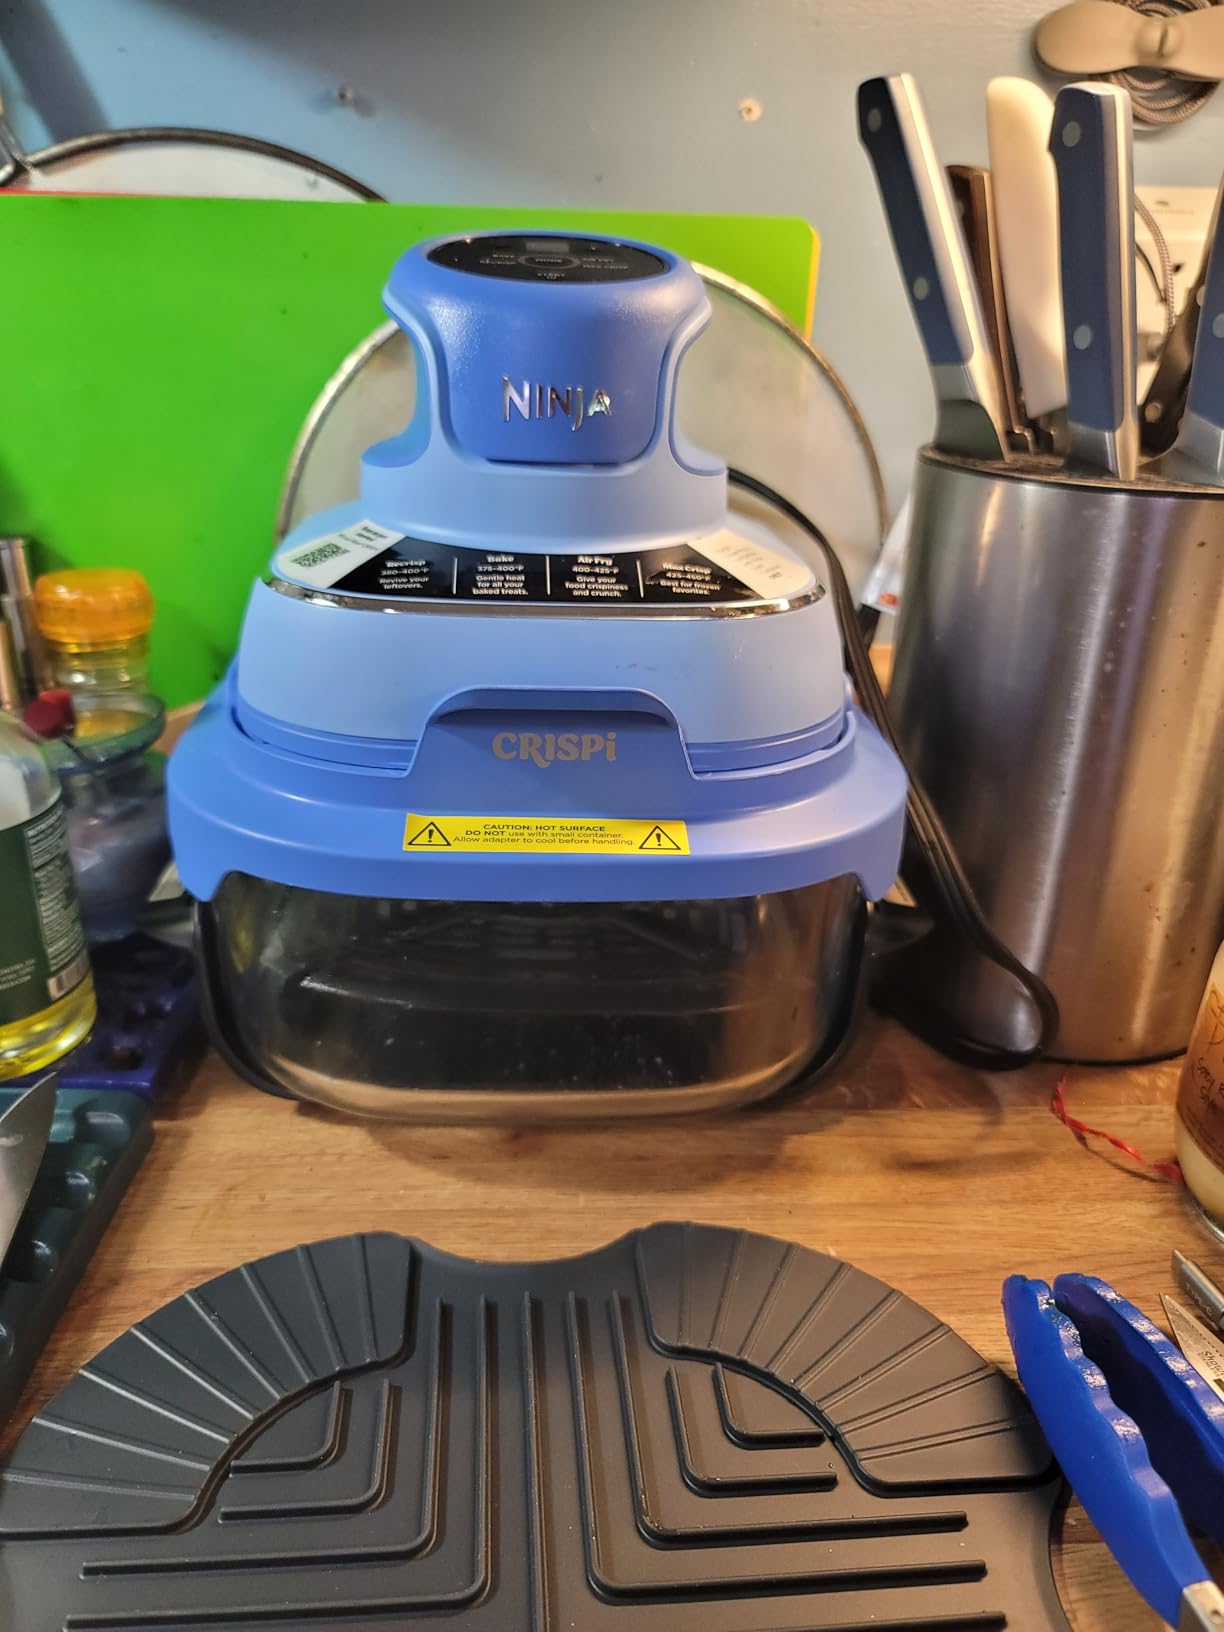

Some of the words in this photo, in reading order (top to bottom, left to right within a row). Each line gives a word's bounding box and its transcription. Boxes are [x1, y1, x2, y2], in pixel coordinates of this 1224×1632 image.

[503, 376, 612, 432] NINJA
[486, 554, 514, 563] Bake
[577, 555, 593, 564] Air
[684, 564, 712, 575] Crisp
[565, 581, 586, 589] food
[587, 583, 629, 591] crispiness
[693, 582, 721, 591] frozen
[672, 587, 711, 595] favorites.
[592, 838, 636, 846] handling.
